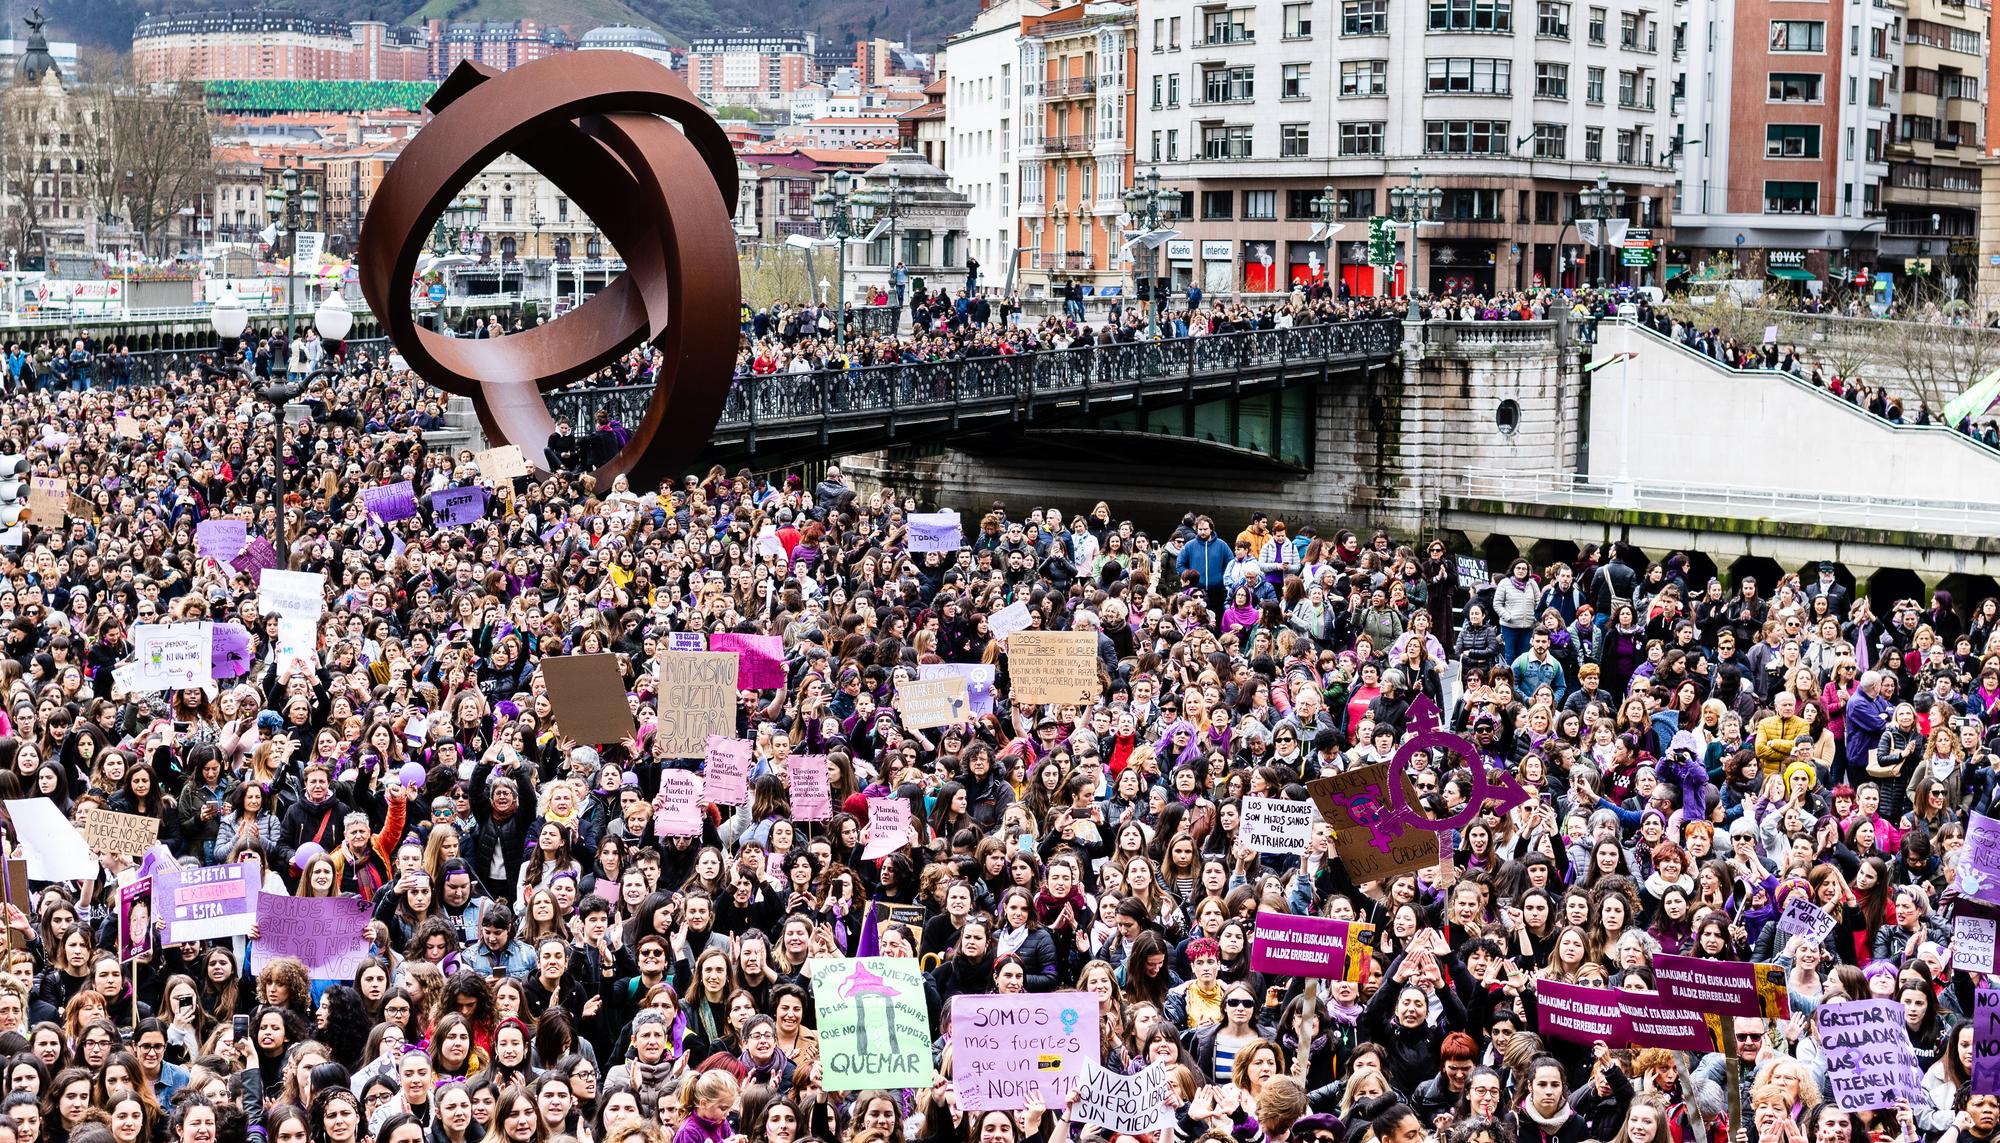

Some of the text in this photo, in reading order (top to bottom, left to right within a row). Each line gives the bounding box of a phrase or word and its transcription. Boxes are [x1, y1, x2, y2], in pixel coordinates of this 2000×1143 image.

[1171, 244, 1190, 254] diseño
[1205, 245, 1229, 255] interior
[1770, 251, 1801, 262] KOVAC
[1458, 556, 1478, 569] QUITA
[1028, 646, 1056, 656] LIBRES
[1066, 647, 1096, 655] IGUALES
[711, 768, 743, 777] masturbate
[1314, 763, 1389, 797] QUIENES NO
[666, 778, 694, 787] Manolo,
[665, 787, 684, 796] hazte
[875, 805, 899, 814] Manolo,
[1248, 801, 1312, 814] LOS VIOLADORES
[91, 810, 153, 831] QUIEN NO SE
[875, 822, 882, 830] la
[876, 814, 893, 822] hazte
[1245, 813, 1309, 826] SON HIJOS SANOS
[88, 823, 133, 840] MUEVE NO
[1271, 825, 1284, 833] DEL
[87, 836, 150, 855] LAS CADENAS
[1350, 854, 1379, 877] SUS
[181, 867, 227, 884] RESPETA
[192, 902, 224, 919] ESPRA
[259, 893, 360, 918] SOMOS EL
[1791, 898, 1817, 914] FIGHT
[1816, 910, 1834, 929] LIKE
[258, 915, 366, 936] GRITO DE LAS
[1787, 907, 1796, 919] A
[1798, 912, 1817, 930] GIRL
[1957, 918, 1980, 927] HASTA
[256, 933, 287, 953] QUE
[291, 938, 318, 957] YA
[324, 936, 349, 956] NO
[1291, 934, 1303, 943] ETA
[1303, 934, 1344, 949] EUSKALDUNA,
[1957, 931, 1994, 943] OVARIOS
[1266, 946, 1330, 964] BI ALDIZ ERREBELDEA!
[867, 961, 885, 970] LAS
[813, 962, 846, 988] SOMOS
[881, 968, 921, 987] NIETAS
[1694, 973, 1707, 985] ETA
[1707, 975, 1754, 990] EUSKALDUNA,
[1672, 985, 1742, 1004] BI ALDIZ ERREBELDEA!
[819, 1001, 927, 1023] DE LAS BRUJAS
[973, 1007, 1049, 1027] SOMOS
[1572, 1002, 1584, 1012] ETA
[1583, 1004, 1621, 1018] EUSKALDUN
[1649, 1008, 1661, 1018] ETA
[1661, 1009, 1703, 1022] EUSKALDUNA,
[1820, 1007, 1885, 1027] GRITAR
[820, 1028, 840, 1040] QUE
[842, 1025, 856, 1035] NO
[1550, 1013, 1613, 1035] BI ALDIZ ERREBELDEA!
[1632, 1022, 1696, 1036] BI ALDIZ ERREBELDEA!
[964, 1034, 1081, 1053] más fuertes
[1822, 1027, 1898, 1050] CALLADAS
[830, 1052, 920, 1076] QUEMAR
[971, 1058, 1030, 1076] que un
[1827, 1053, 1856, 1072] LAS
[1862, 1051, 1895, 1066] QUE
[1088, 1061, 1166, 1098] VIVAS NOS
[1833, 1070, 1895, 1092] TIENEN
[988, 1079, 1039, 1099] NOKIA
[1080, 1084, 1168, 1116] QUIERO, LIBRE
[1841, 1092, 1875, 1109] QUE
[1079, 1103, 1159, 1132] SIN MIEDO
